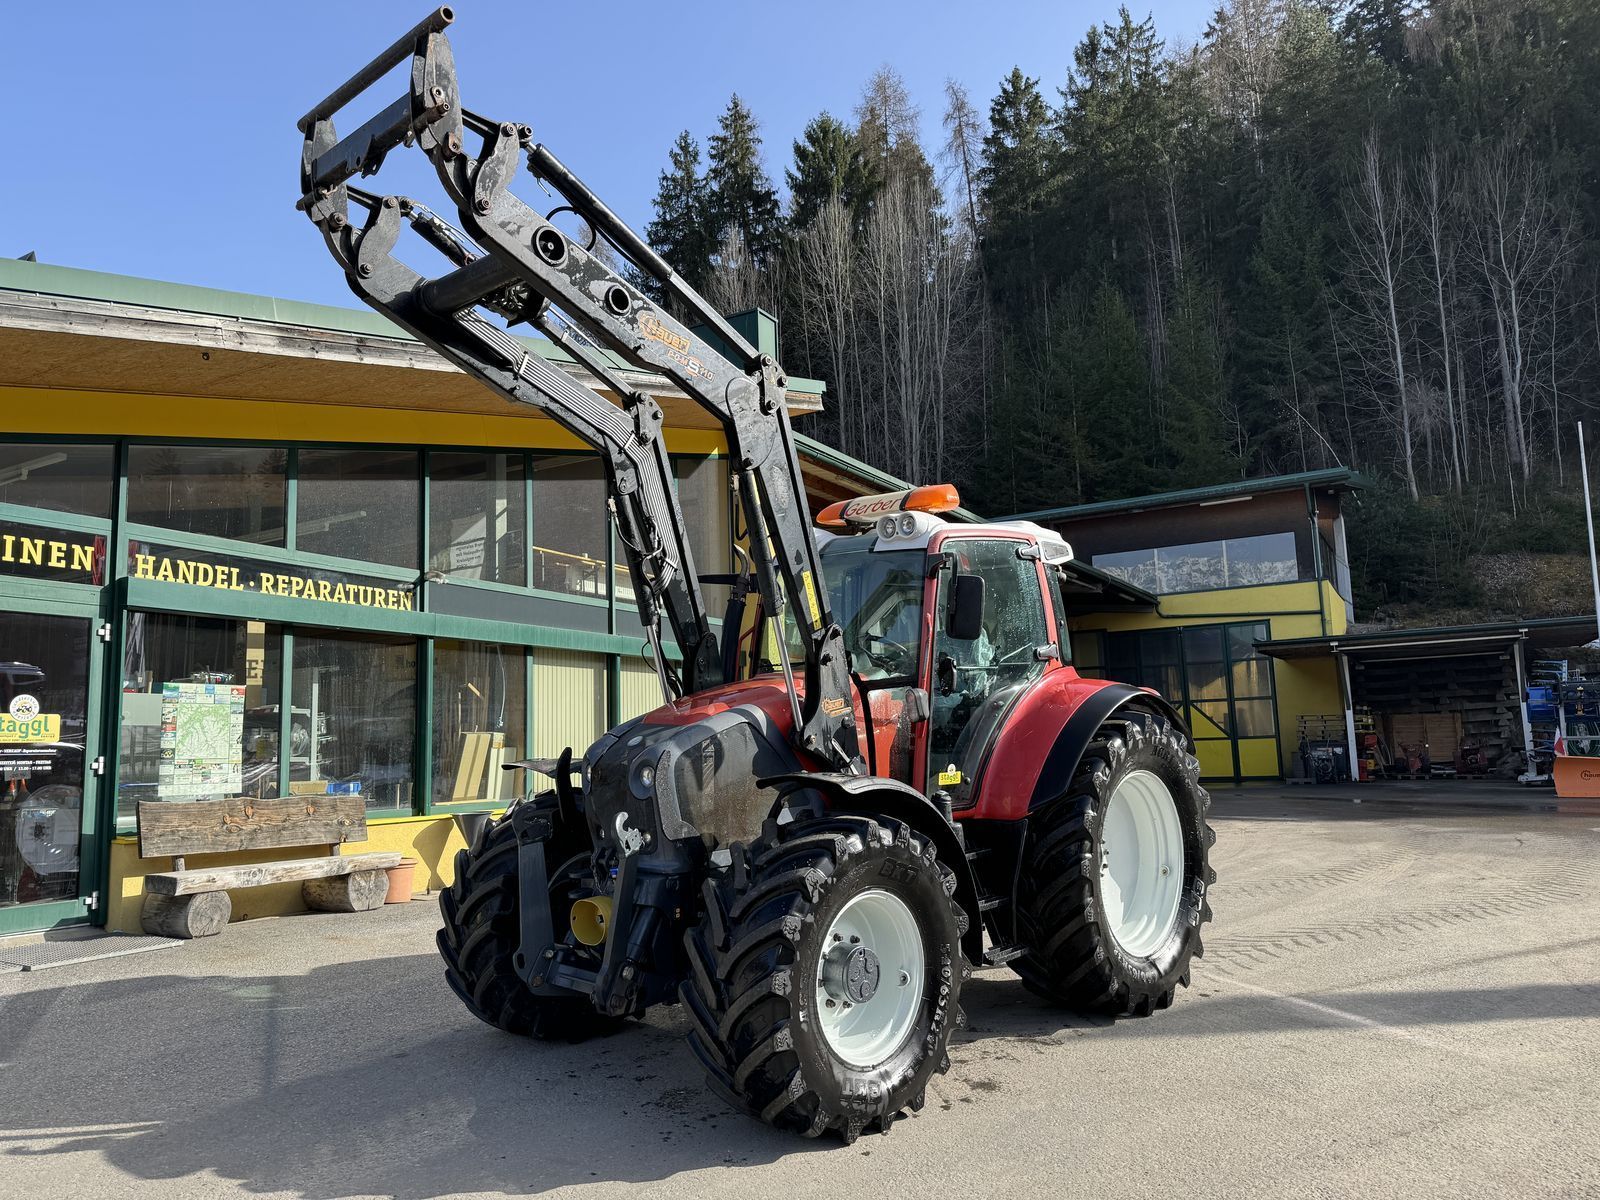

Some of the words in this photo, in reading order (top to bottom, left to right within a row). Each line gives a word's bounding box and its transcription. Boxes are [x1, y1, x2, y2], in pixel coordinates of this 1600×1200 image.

[845, 499, 900, 517] Gerber
[2, 534, 95, 571] INEN
[134, 553, 245, 591] HANDEL
[260, 572, 414, 611] REPARATUREN
